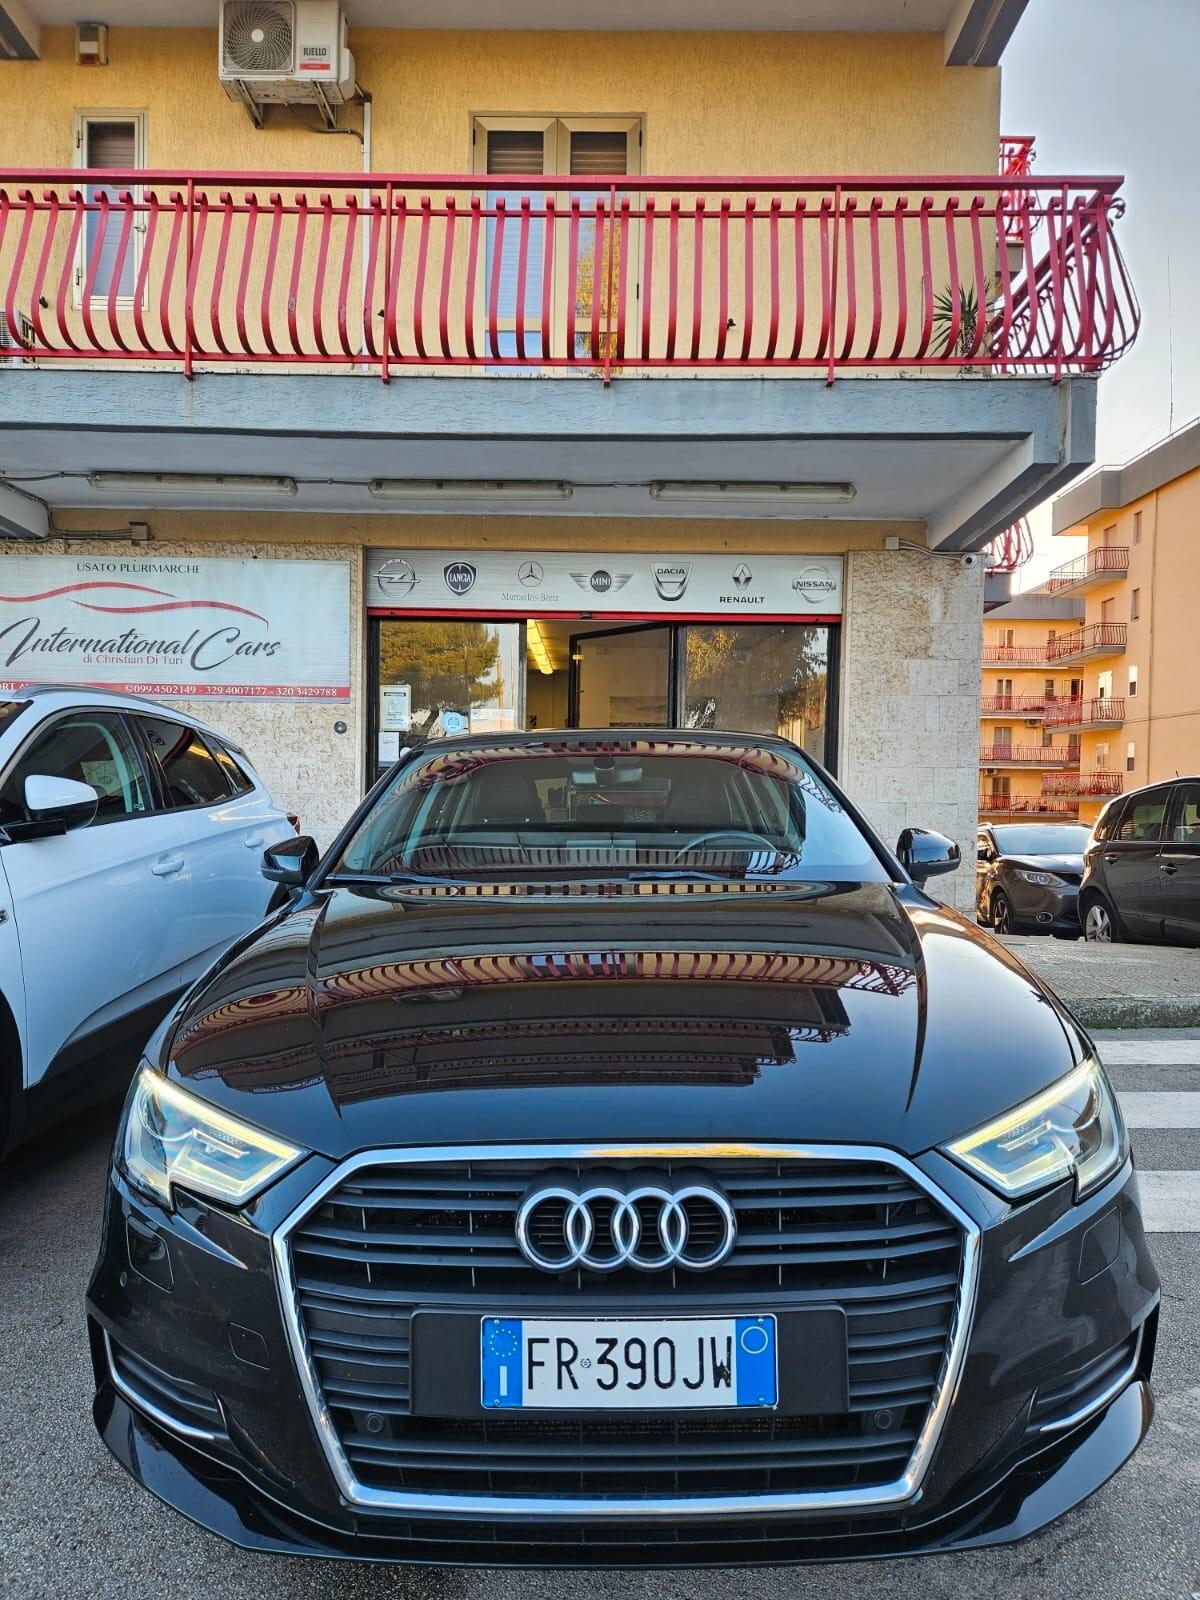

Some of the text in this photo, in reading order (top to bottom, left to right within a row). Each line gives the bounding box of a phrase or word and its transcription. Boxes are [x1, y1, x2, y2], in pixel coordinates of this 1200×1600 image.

[303, 47, 327, 56] RIELLO
[77, 562, 201, 574] USATO PLURIMARCHE
[449, 572, 471, 582] LANCIA
[591, 577, 611, 586] MINI
[796, 580, 833, 588] NISSAN
[501, 592, 560, 602] Mercedes-Benz
[719, 596, 765, 604] RENAULT
[0, 616, 282, 671] International Cars
[82, 654, 183, 665] di Christian Di Turi
[499, 1365, 508, 1397] I
